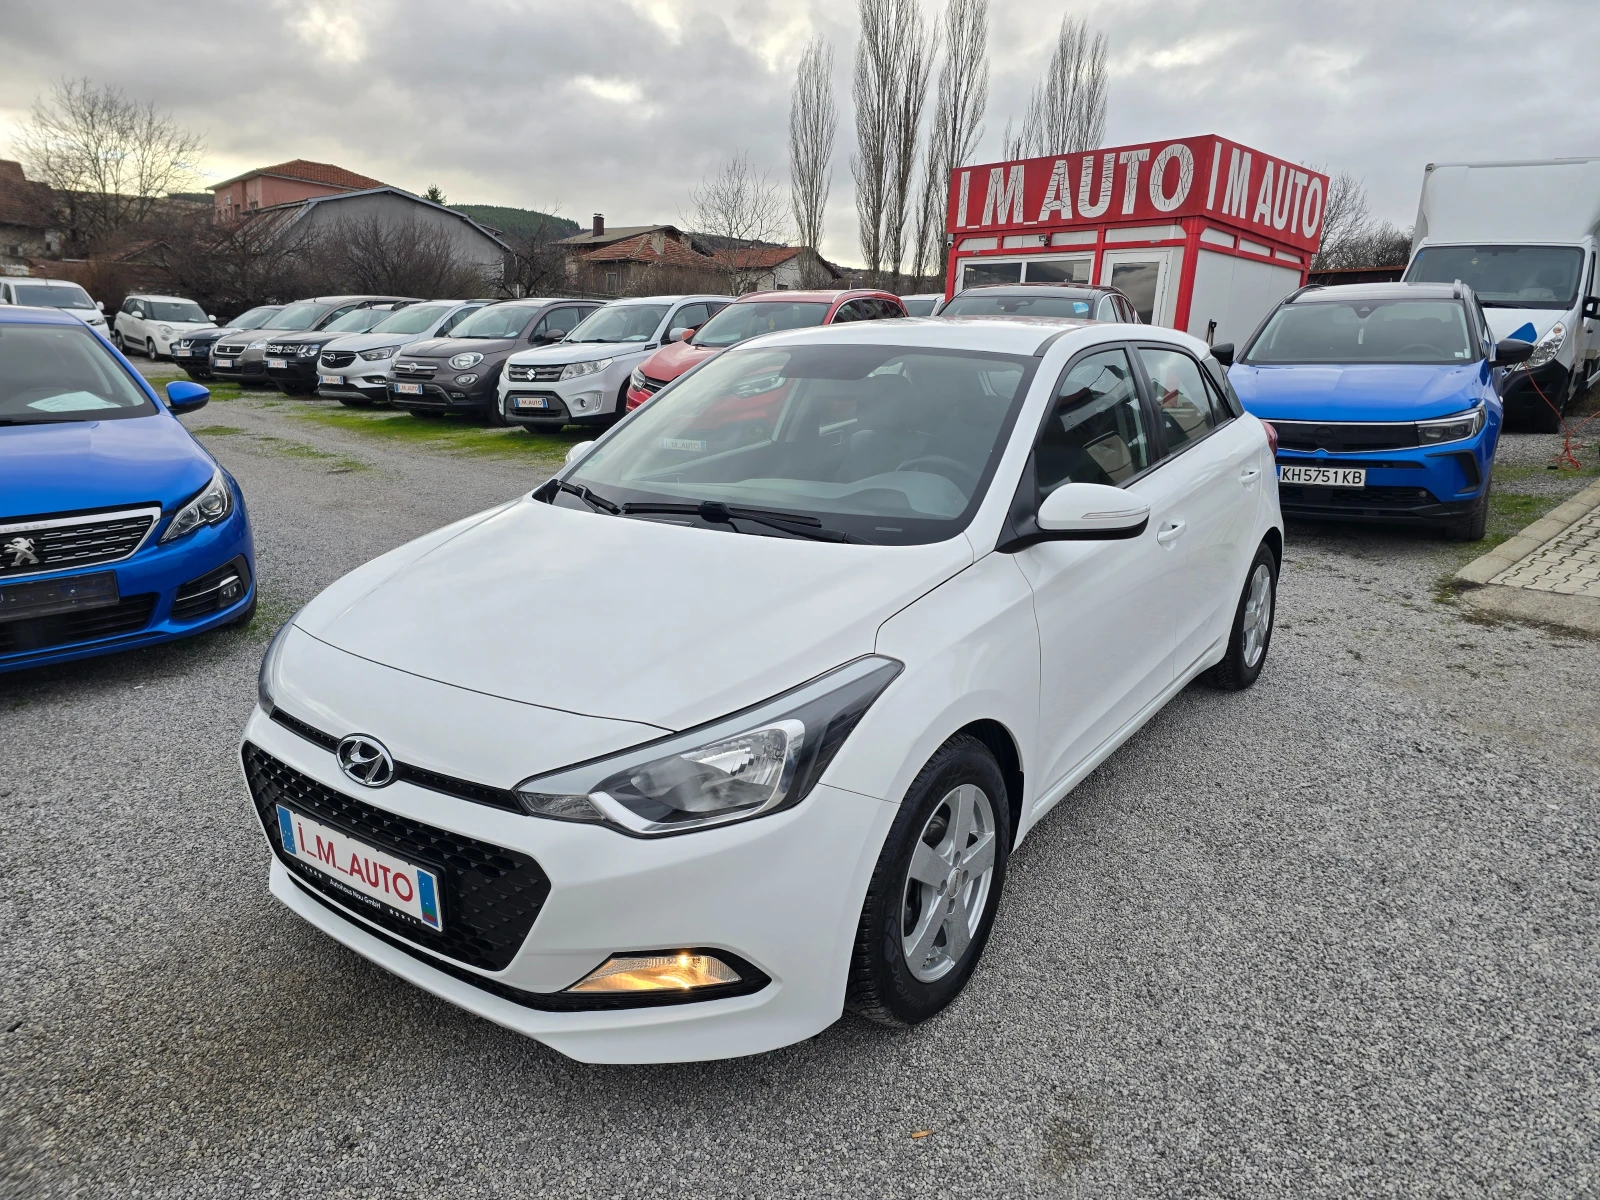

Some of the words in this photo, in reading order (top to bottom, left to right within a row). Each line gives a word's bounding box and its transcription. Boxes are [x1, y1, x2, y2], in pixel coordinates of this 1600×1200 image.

[1206, 141, 1222, 211] I
[1222, 147, 1252, 219] M
[1252, 160, 1323, 240] AUTO
[1281, 467, 1362, 485] KH5751KB
[364, 896, 381, 910] GmbH
